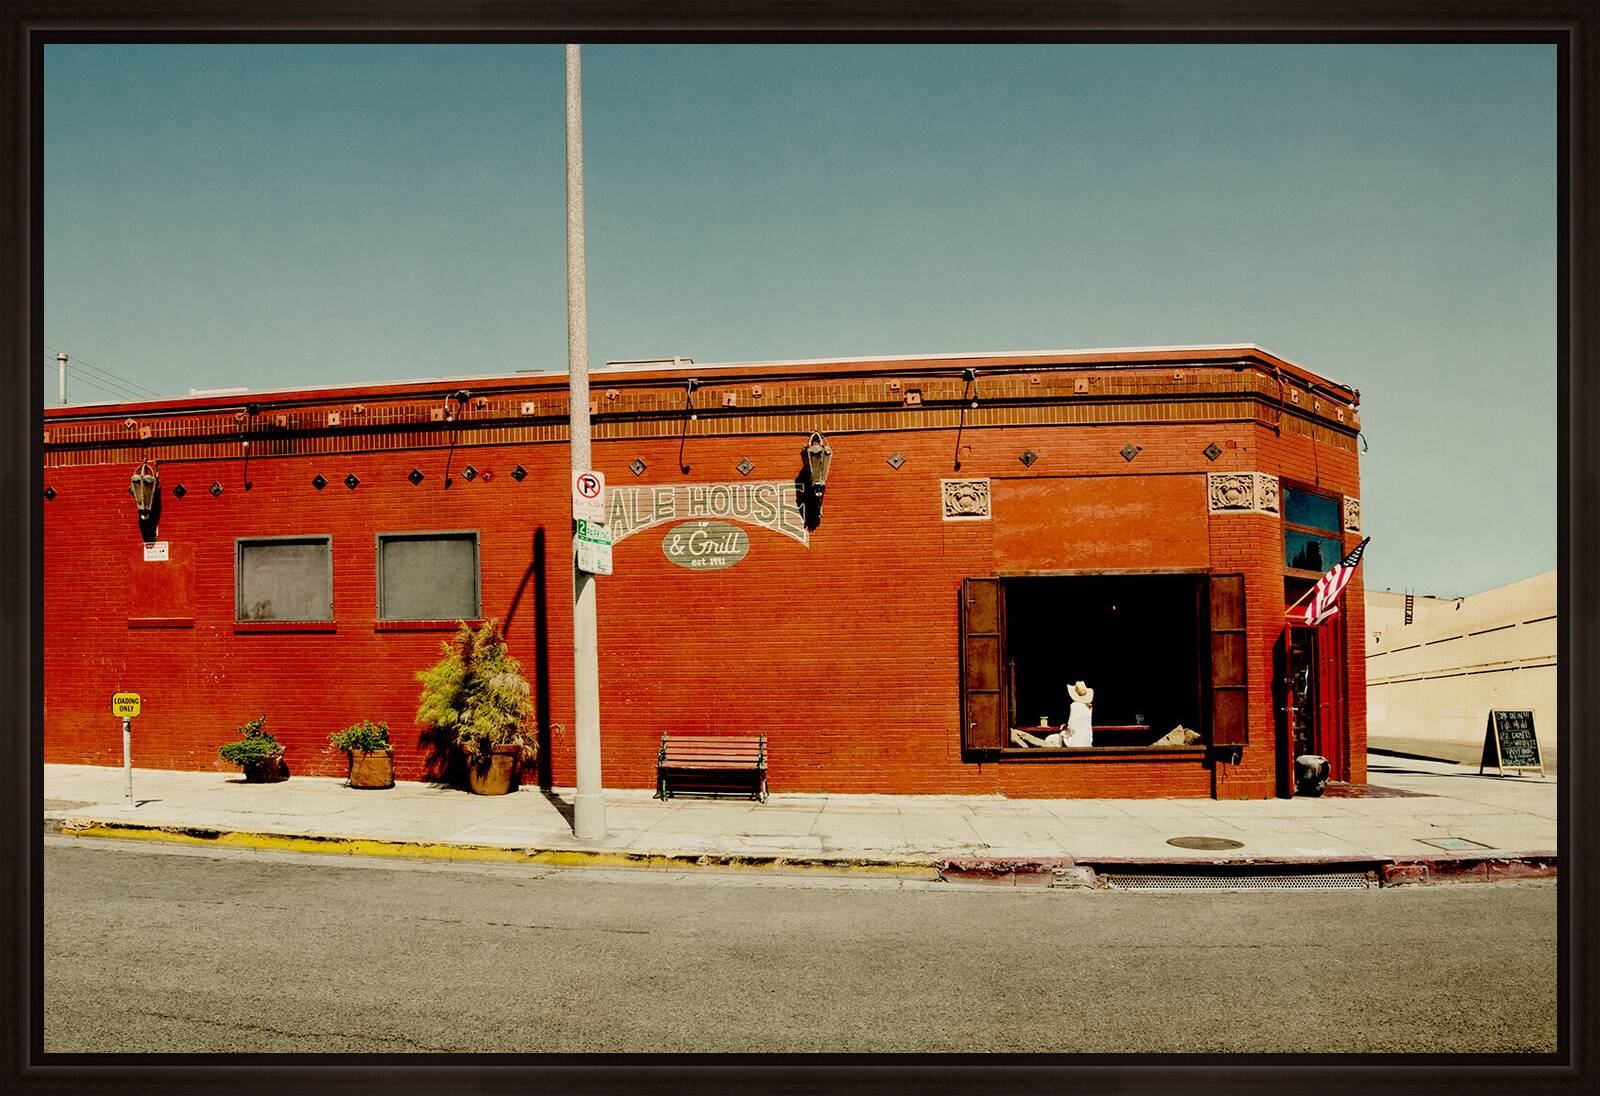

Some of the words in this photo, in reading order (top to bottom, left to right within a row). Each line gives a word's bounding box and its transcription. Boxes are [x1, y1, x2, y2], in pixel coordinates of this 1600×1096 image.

[609, 488, 675, 540] ALE
[687, 483, 808, 543] HOUSE
[669, 533, 686, 556] &
[688, 530, 741, 556] Grill
